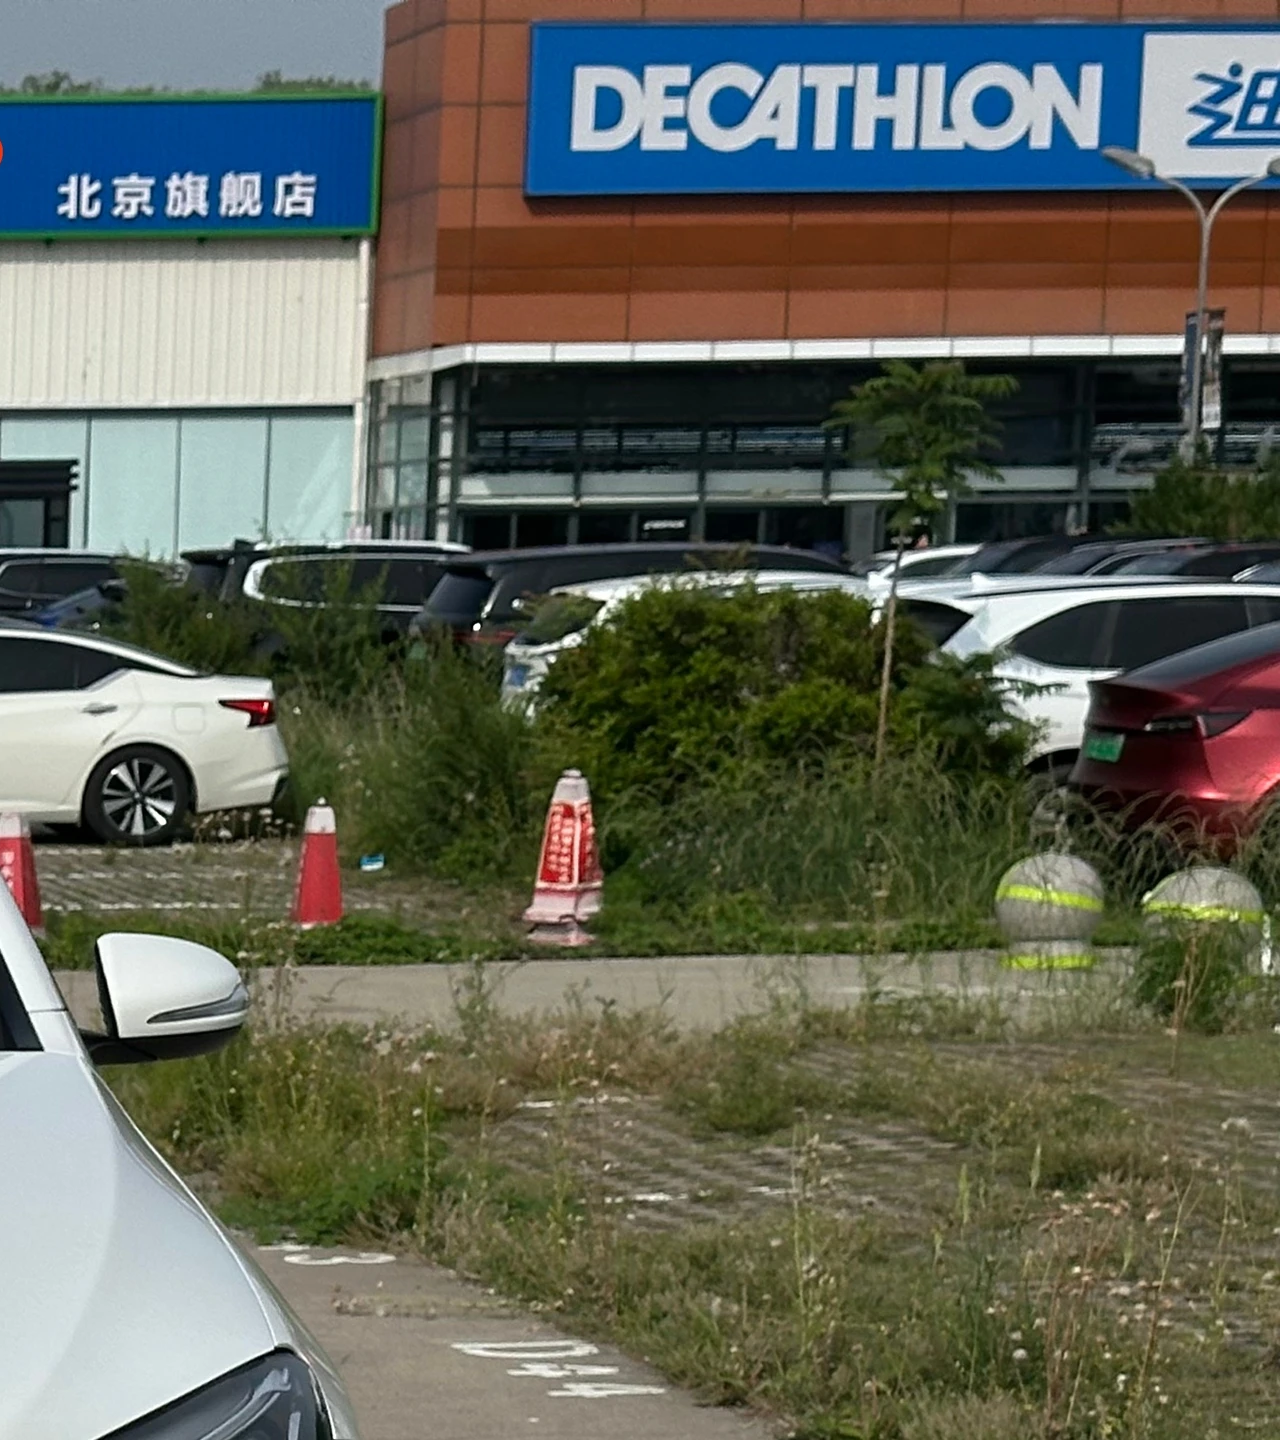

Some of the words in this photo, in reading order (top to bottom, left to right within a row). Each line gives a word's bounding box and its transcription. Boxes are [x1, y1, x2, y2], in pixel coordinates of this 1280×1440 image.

[570, 62, 1103, 152] DECATHLON
[57, 171, 317, 219] 北京旗舰店
